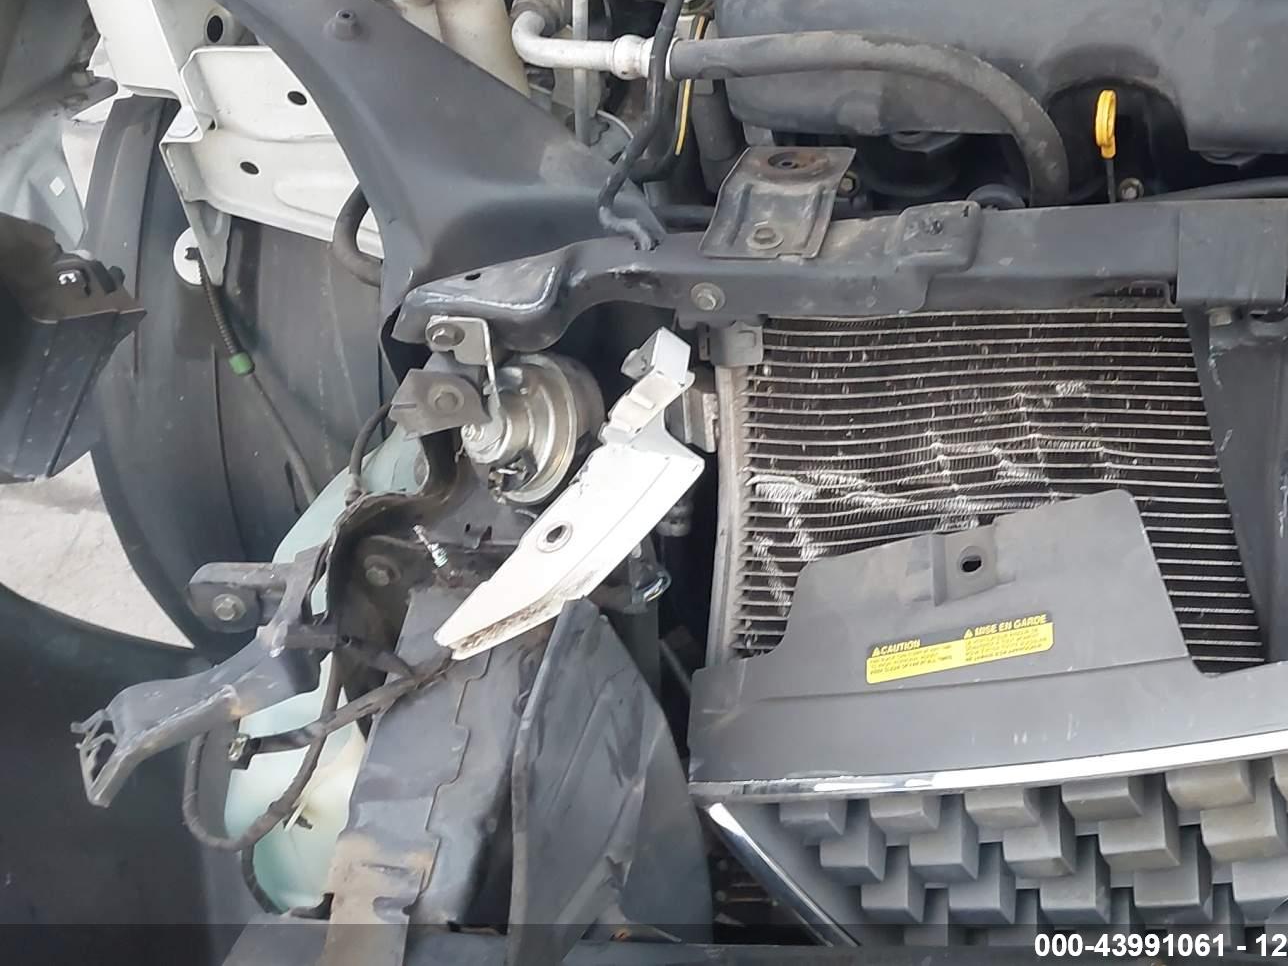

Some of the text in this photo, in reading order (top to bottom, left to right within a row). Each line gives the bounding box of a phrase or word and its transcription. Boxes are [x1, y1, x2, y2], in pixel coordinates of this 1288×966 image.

[974, 614, 1047, 637] MISE EN GARDE
[880, 639, 921, 655] CAUTION
